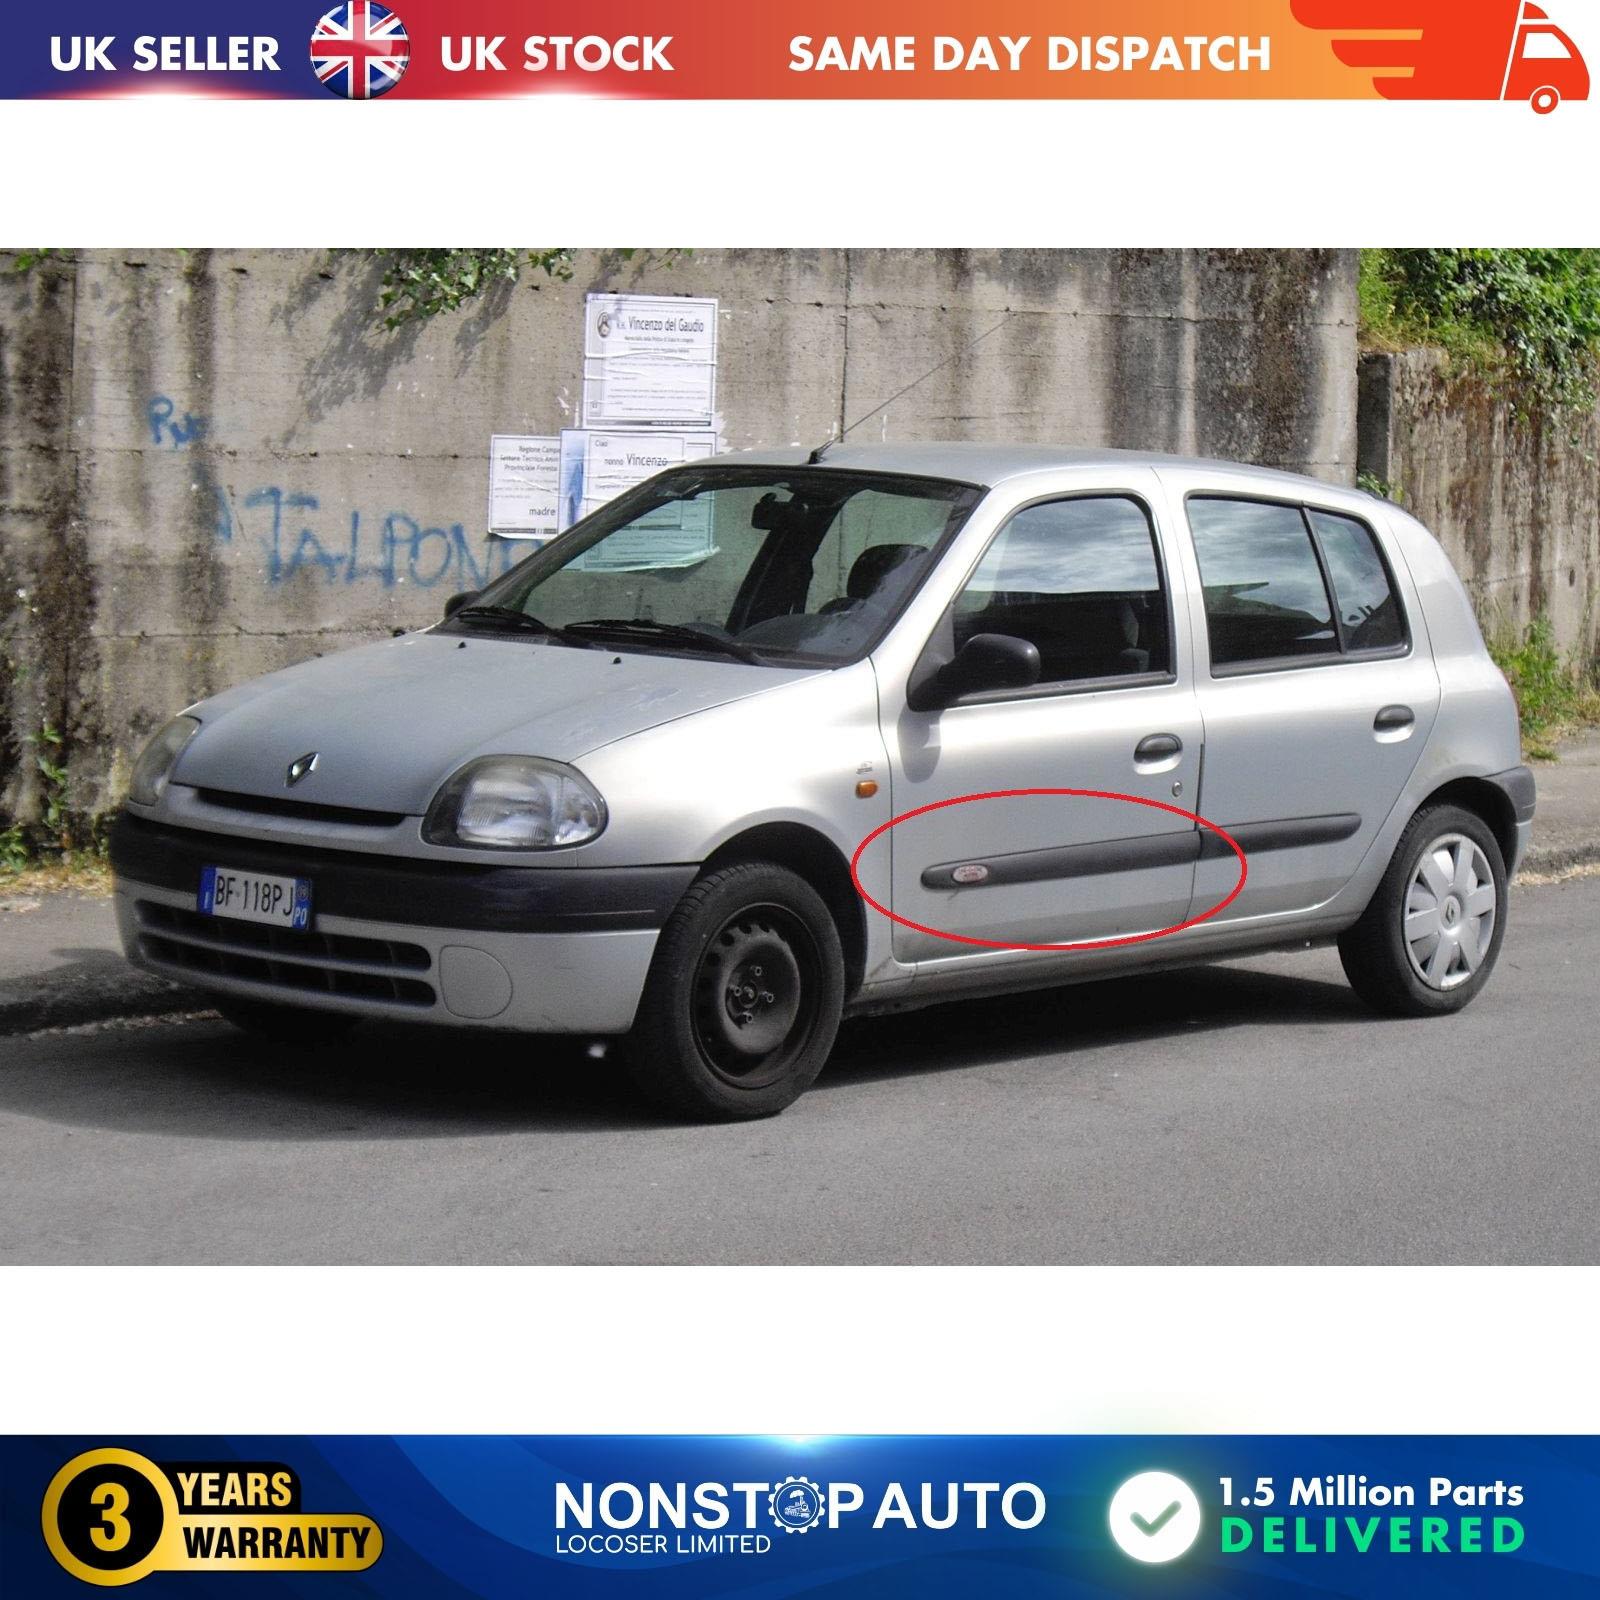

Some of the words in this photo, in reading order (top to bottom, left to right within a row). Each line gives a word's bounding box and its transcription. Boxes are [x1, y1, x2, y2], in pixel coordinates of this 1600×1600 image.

[628, 315, 663, 331] Vincenzo
[664, 317, 677, 332] del
[679, 317, 705, 333] Gaudio
[626, 453, 668, 466] Vincenzo
[529, 507, 556, 516] madre
